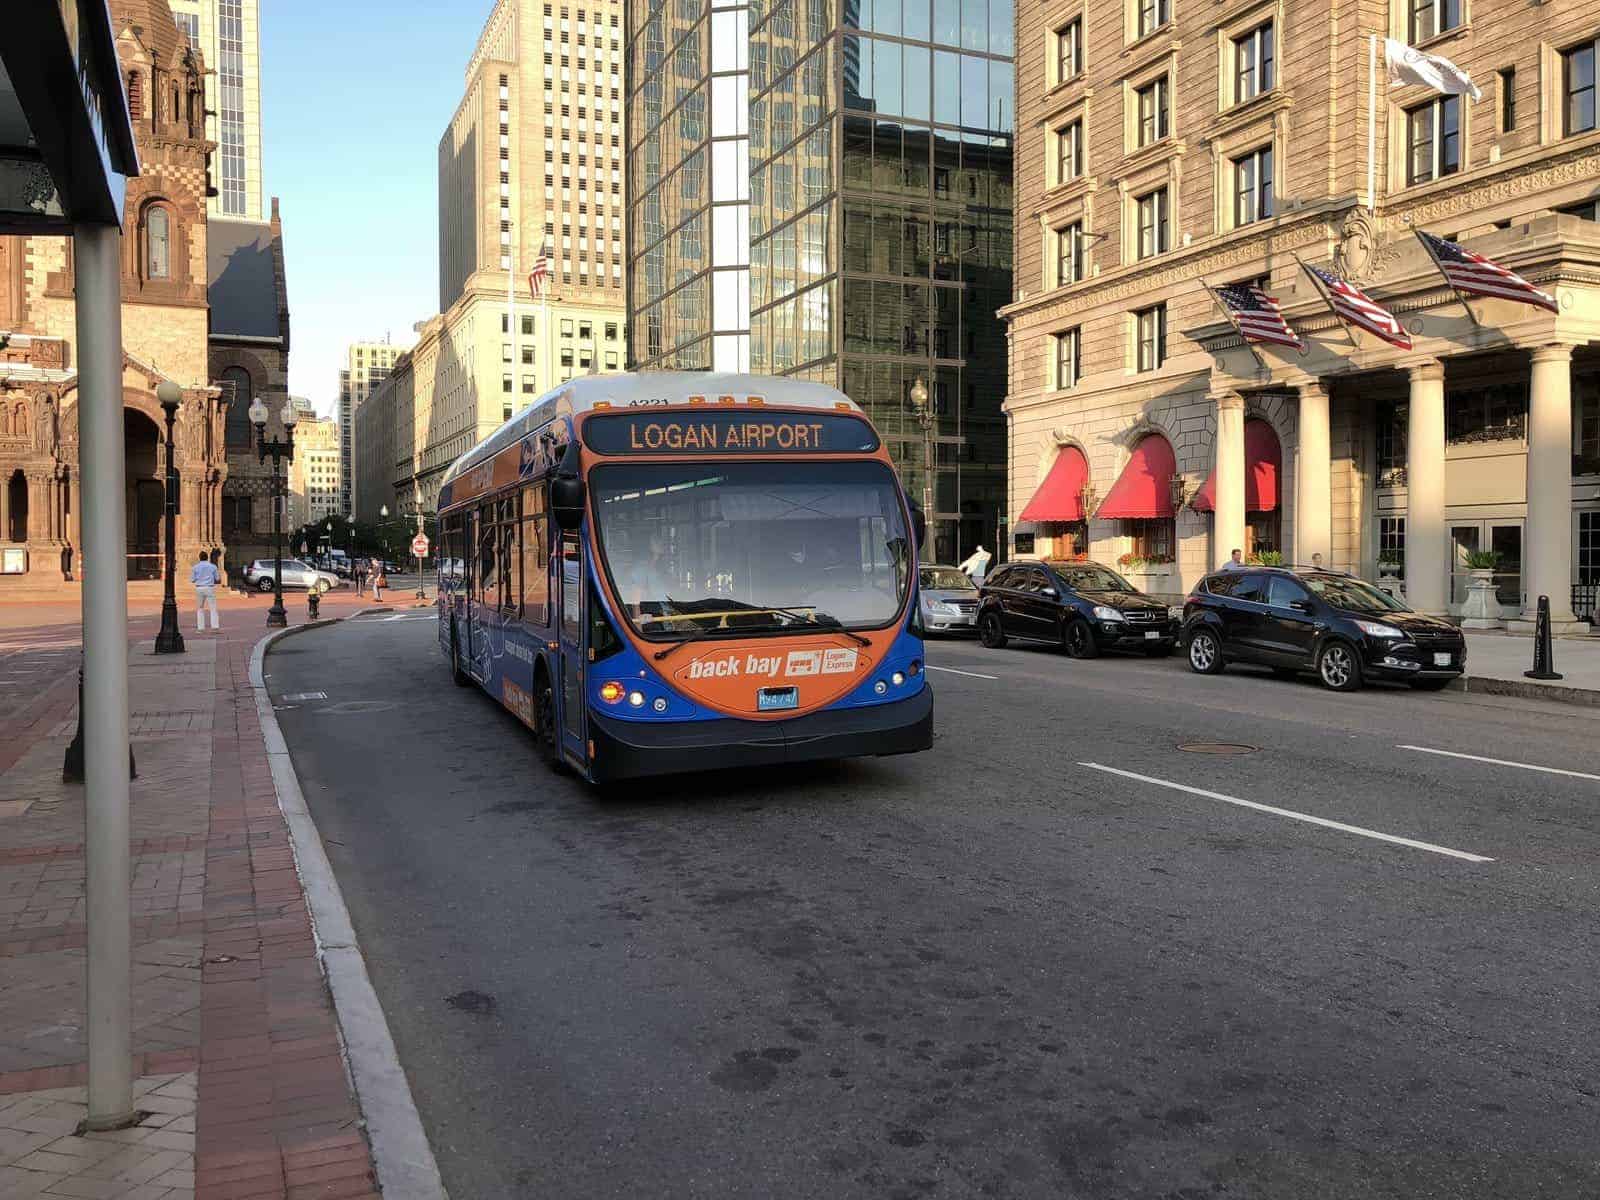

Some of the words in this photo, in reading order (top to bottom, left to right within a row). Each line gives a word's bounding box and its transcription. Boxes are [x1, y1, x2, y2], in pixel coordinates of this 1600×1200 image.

[630, 423, 718, 449] LOGAN
[724, 423, 824, 449] AIRPORT
[690, 656, 741, 679] back
[745, 655, 783, 677] bay
